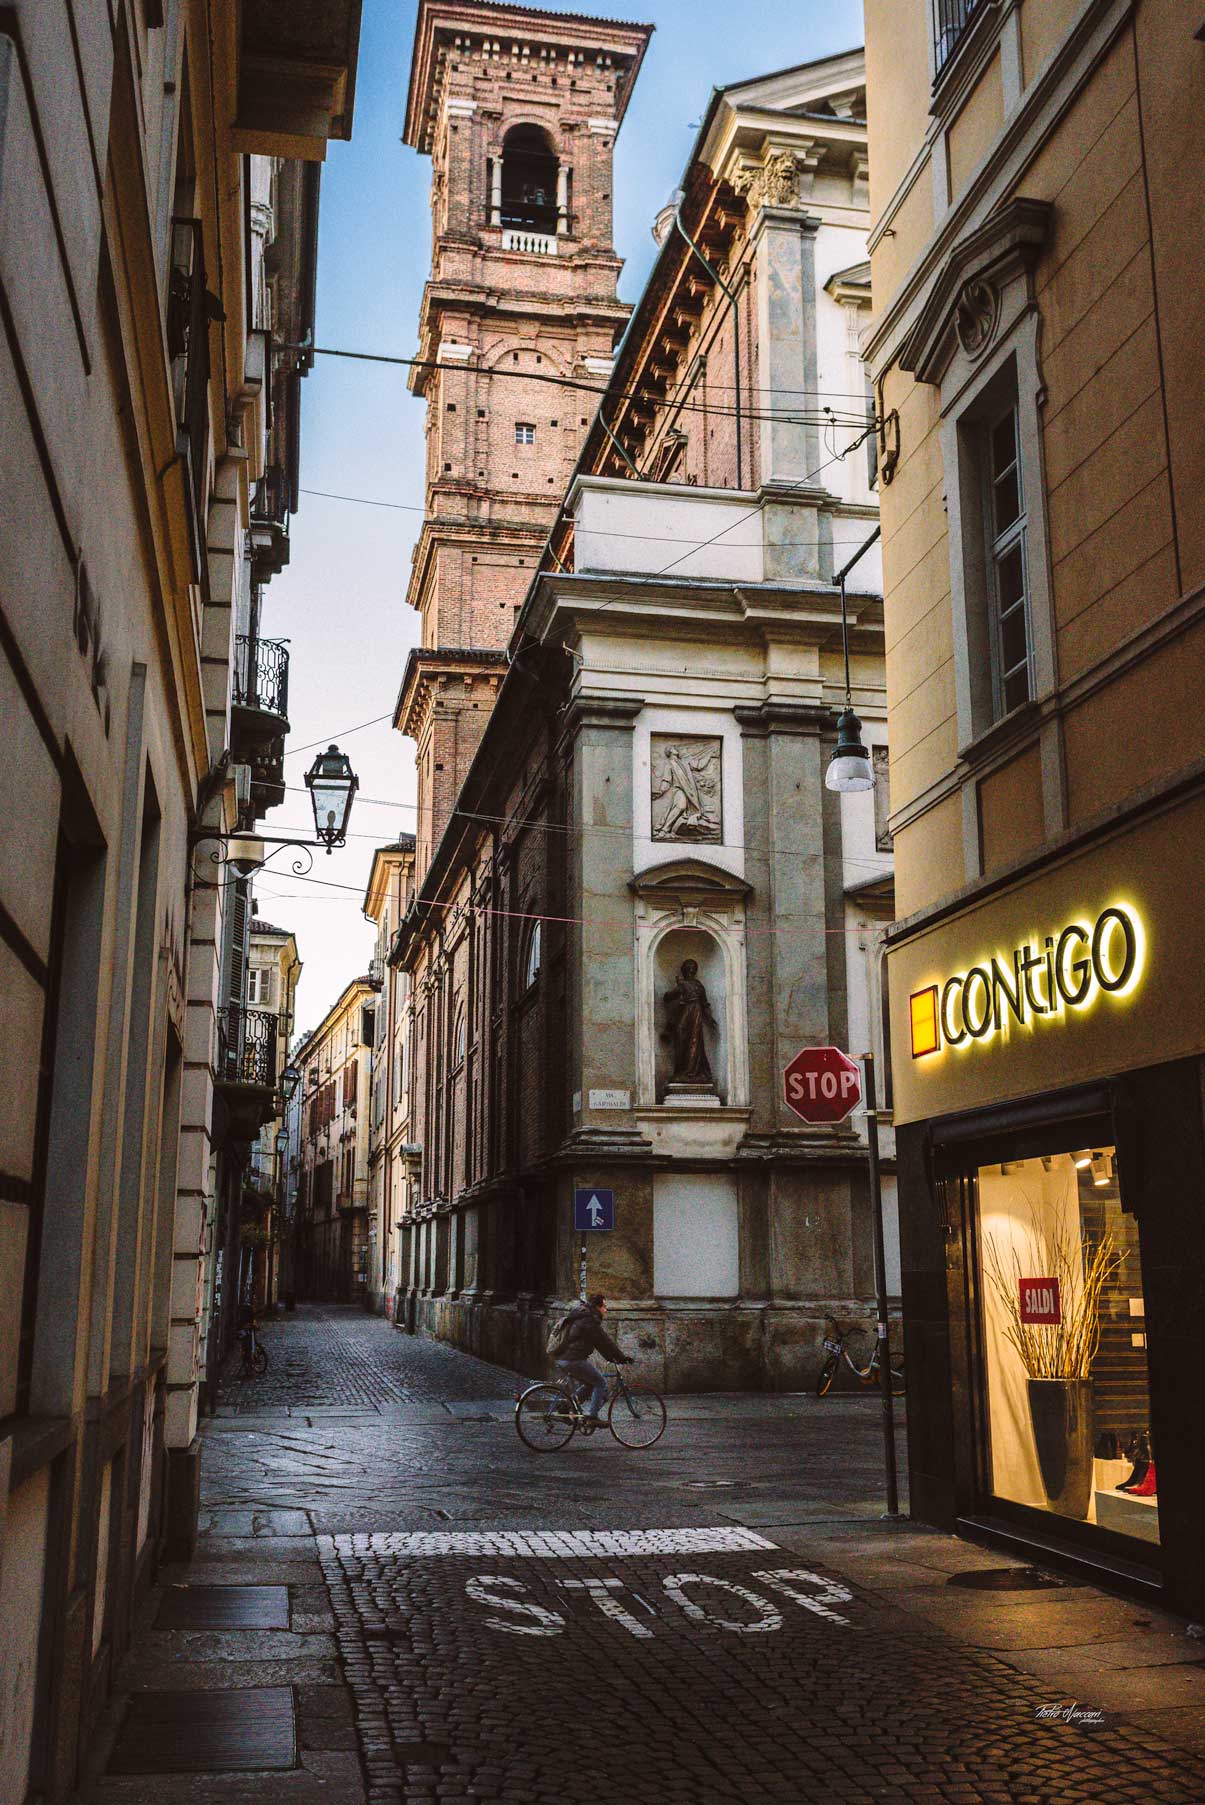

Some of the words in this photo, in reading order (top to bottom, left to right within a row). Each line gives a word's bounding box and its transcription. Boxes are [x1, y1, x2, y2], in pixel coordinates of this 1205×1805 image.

[788, 1071, 855, 1100] STOP
[1025, 1288, 1055, 1314] SALDI
[465, 1568, 853, 1639] STOP
